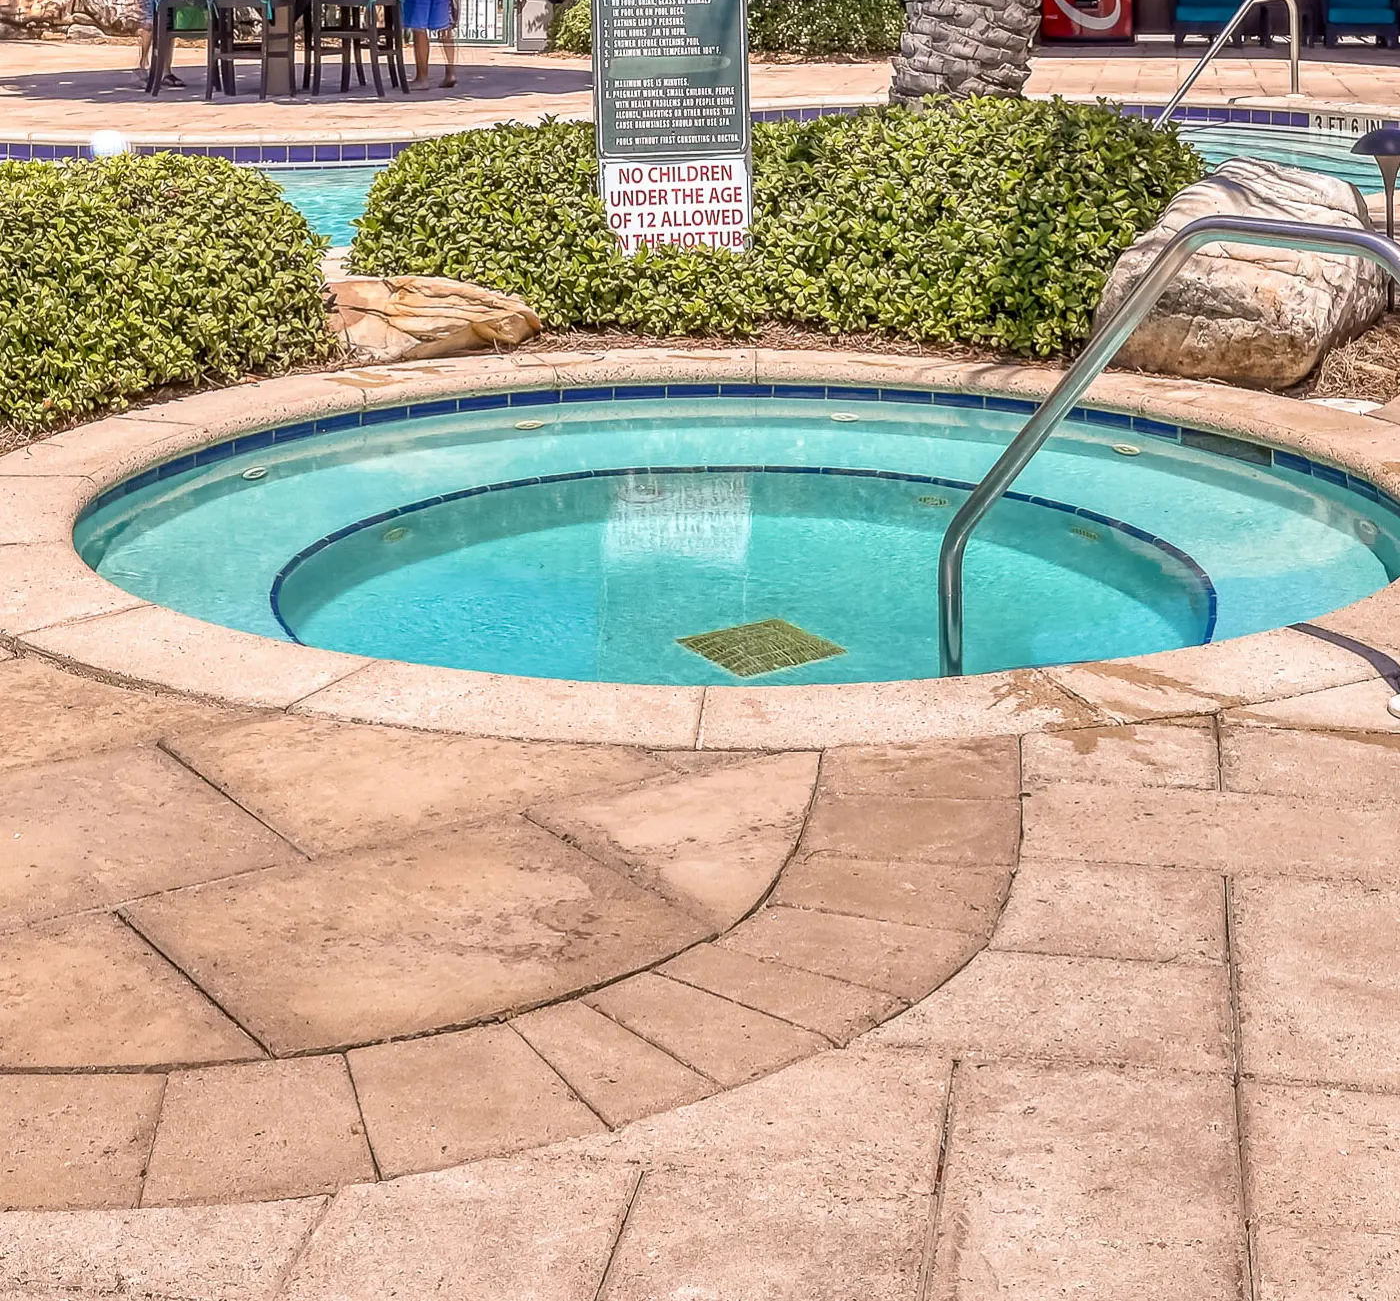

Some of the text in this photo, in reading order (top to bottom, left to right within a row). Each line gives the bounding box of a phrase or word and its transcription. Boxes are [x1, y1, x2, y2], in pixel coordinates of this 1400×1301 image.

[612, 6, 686, 17] IN POOL OR ON POOL DECK.
[604, 19, 610, 28] 2.
[613, 19, 637, 27] BATHING
[638, 18, 653, 27] LOAD
[659, 17, 686, 26] PERSONS.
[604, 30, 610, 38] 3.
[613, 29, 628, 38] POOL
[628, 29, 647, 37] HOURS
[651, 28, 660, 37] AM
[662, 28, 670, 36] TO
[614, 39, 636, 48] SHOWER
[637, 38, 658, 47] BEFORE
[659, 38, 685, 47] ENTERING
[686, 37, 700, 46] POOL
[614, 48, 641, 57] MAXIMUM
[642, 48, 661, 56] WATER
[663, 47, 701, 56] TEMPERATURE
[614, 80, 641, 88] MAXIMUM
[642, 79, 654, 88] USE
[655, 79, 661, 87] 15
[663, 78, 689, 87] MINUTES.
[612, 90, 641, 99] PREGNANT
[667, 88, 684, 97] SMALL
[715, 86, 735, 95] PEOPLE
[615, 97, 734, 109] WITH HEALTH PROBLEMS AND PEOPLE USING
[642, 109, 673, 118] NARCOTICS
[674, 109, 682, 117] OR
[683, 108, 701, 117] OTHER
[702, 108, 720, 116] DRUGS
[722, 107, 736, 115] THAT
[615, 117, 730, 129] CAUSE DROWSINESS SHOULD NOT USE SPA
[1315, 115, 1380, 135] 3 FT 6 IN
[615, 137, 633, 146] POOLS
[634, 136, 659, 145] WITHOUT
[660, 136, 676, 144] FIRST
[676, 134, 710, 144] CONSULTING
[717, 133, 740, 143] DOCTOR.
[619, 165, 733, 184] NO CHILDREN
[610, 186, 743, 207] UNDER THE AGE
[610, 209, 744, 229] OF 12 ALLOWED
[617, 231, 744, 252] N THE HOT TUB
